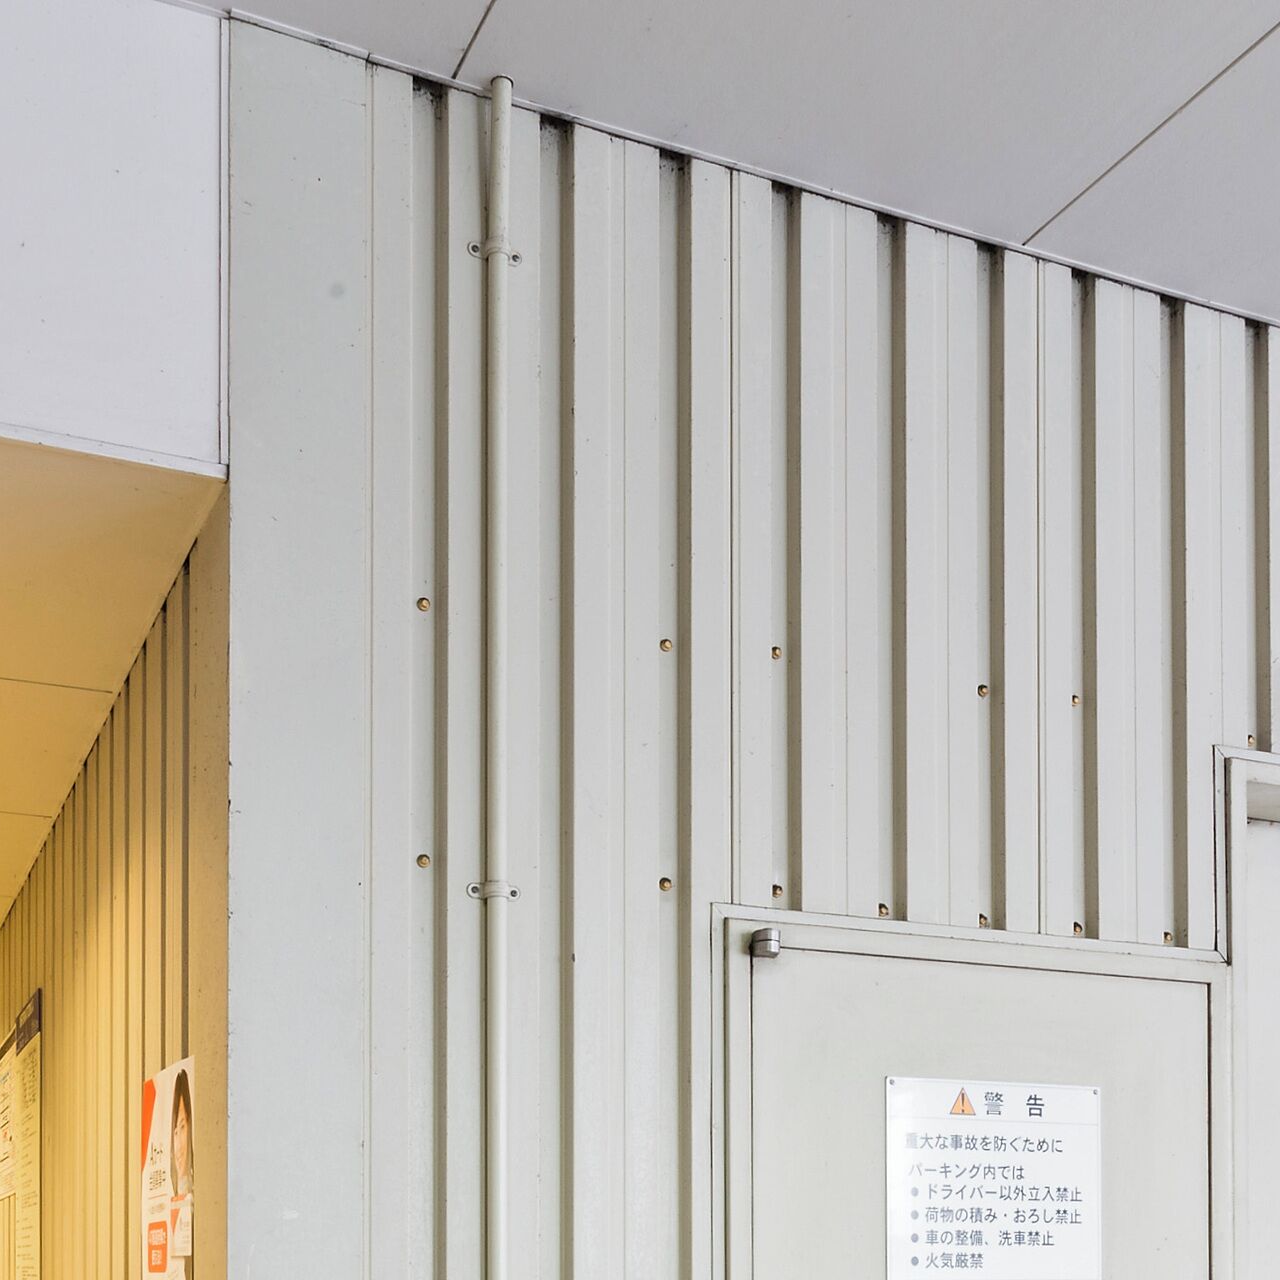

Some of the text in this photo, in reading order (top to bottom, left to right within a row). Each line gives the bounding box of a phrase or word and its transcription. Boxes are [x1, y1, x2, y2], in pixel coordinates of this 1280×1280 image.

[985, 1092, 1045, 1118] 警告
[905, 1133, 1063, 1153] 重大な事故を防ぐために
[909, 1163, 1025, 1180] パーキング内では
[928, 1183, 1082, 1203] ドライバー以外立入禁止
[925, 1207, 1082, 1225] 荷物の積み・おろし禁止
[925, 1230, 1054, 1247] 車の整備、洗車禁止
[926, 1252, 984, 1269] 火気厳禁
